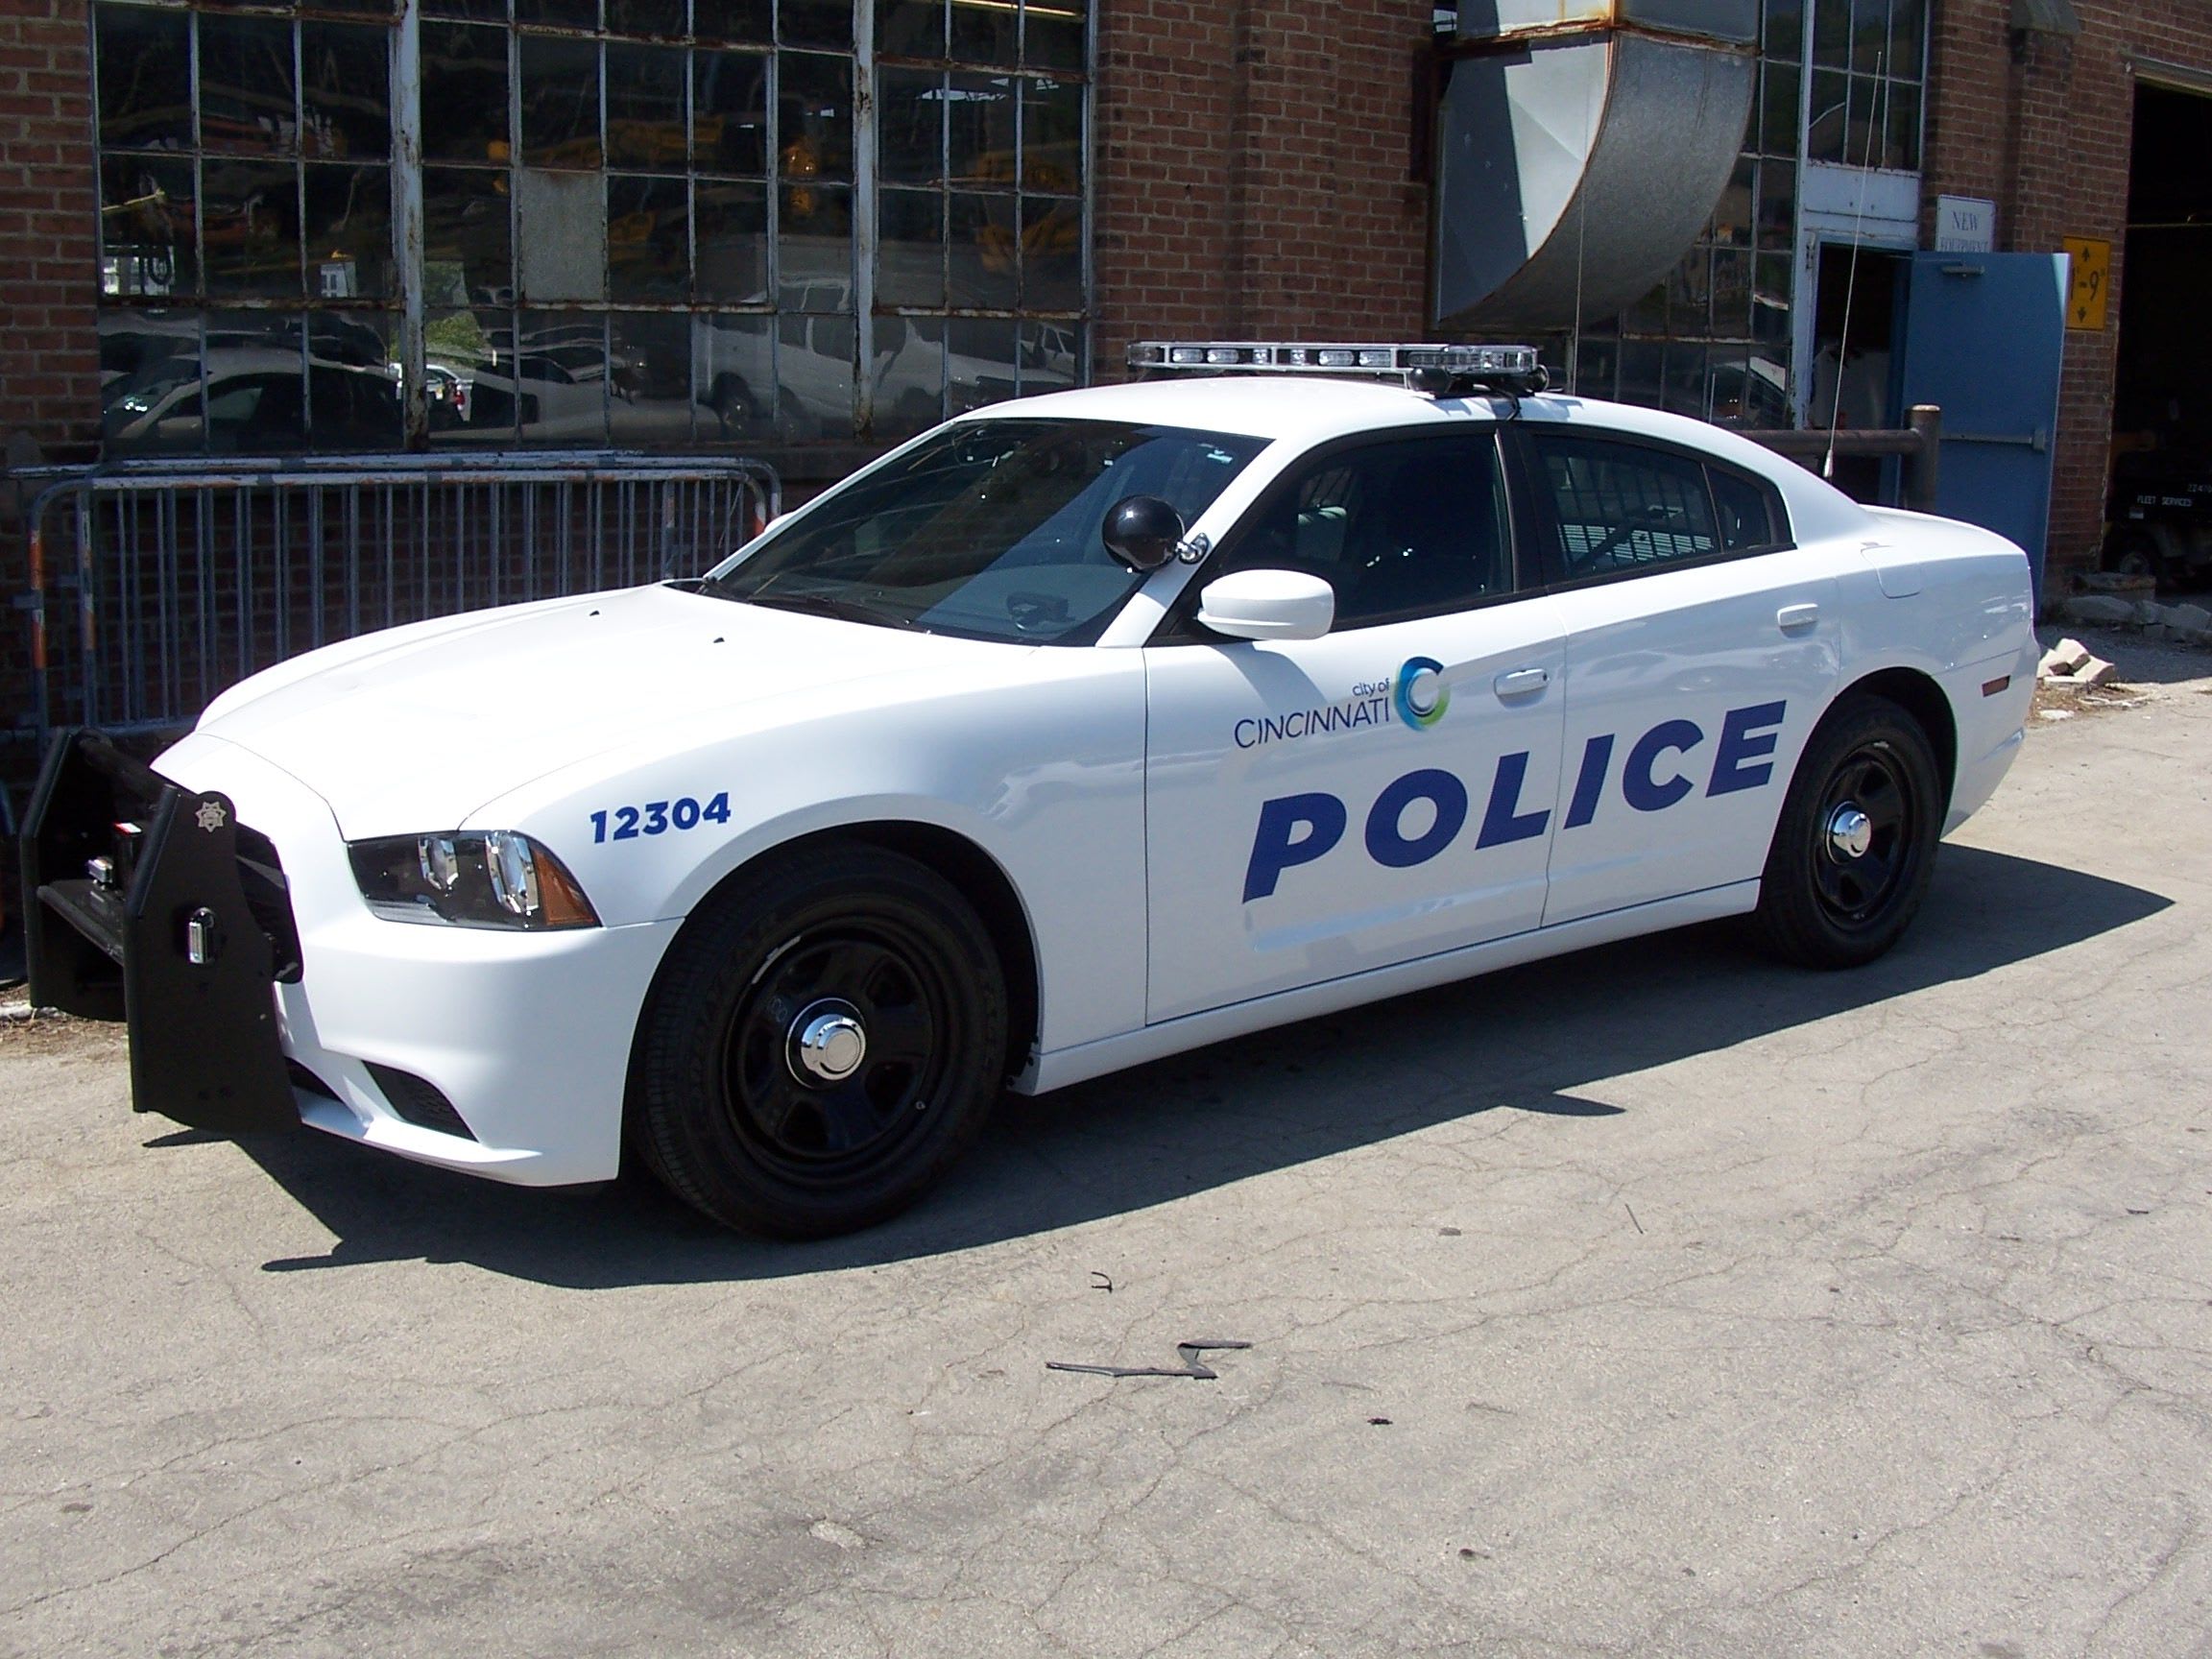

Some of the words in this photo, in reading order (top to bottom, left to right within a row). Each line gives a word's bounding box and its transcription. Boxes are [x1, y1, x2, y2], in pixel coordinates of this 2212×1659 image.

[1951, 210, 1981, 231] NEW
[1352, 682, 1376, 697] city
[1378, 677, 1390, 692] of
[1234, 696, 1390, 749] CINCINNATI
[589, 791, 732, 844] 12304
[1242, 700, 1787, 904] POLICE
